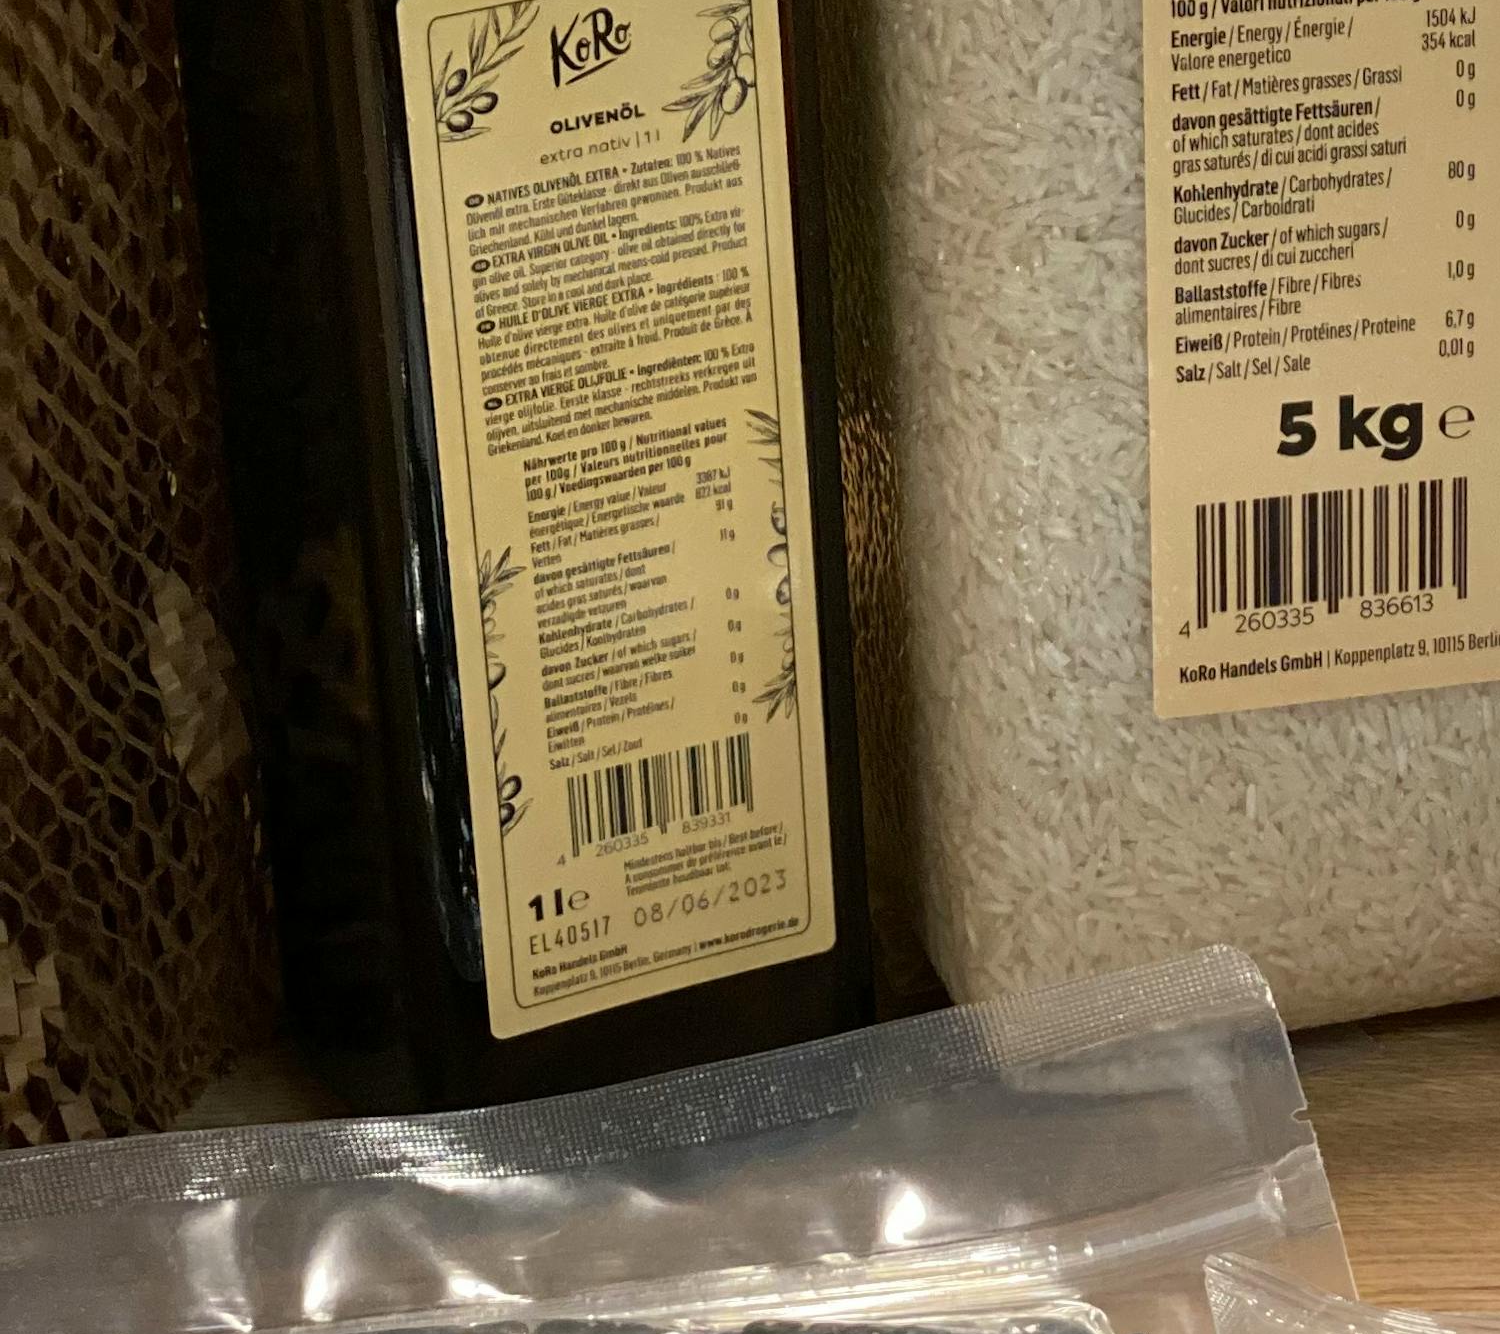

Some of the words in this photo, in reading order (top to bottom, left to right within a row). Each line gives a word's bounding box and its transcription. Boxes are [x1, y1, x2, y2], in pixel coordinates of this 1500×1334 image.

[1426, 7, 1456, 28] 1504
[1460, 5, 1476, 25] kJ
[550, 7, 632, 87] KoRo
[1421, 31, 1446, 52] 354
[1448, 29, 1476, 48] kcal
[549, 101, 645, 134] OLIVENÖL
[539, 146, 583, 165] extra
[588, 136, 631, 155] nativ
[643, 130, 651, 144] 1
[655, 129, 660, 141] l
[487, 184, 531, 206] NATIVES
[532, 171, 583, 195] OLIVENÖL
[585, 165, 620, 184] EXTRA
[492, 249, 526, 269] EXTRA
[526, 242, 561, 260] VIRGIN
[563, 234, 591, 253] OLIVE
[592, 231, 610, 246] OIL
[1277, 400, 1317, 457] 5
[1338, 396, 1423, 462] kg
[1178, 619, 1190, 639] 4
[1234, 606, 1315, 635] 260335
[1359, 594, 1434, 619] 836613
[1179, 664, 1216, 684] KoRo
[1219, 656, 1277, 680] Handels
[1280, 650, 1323, 672] GmbH
[1334, 642, 1415, 667] Koppenplatz
[557, 854, 566, 866] 4
[681, 811, 731, 834] 839331
[634, 869, 787, 927] 08/06/2023
[530, 916, 610, 955] EL40517
